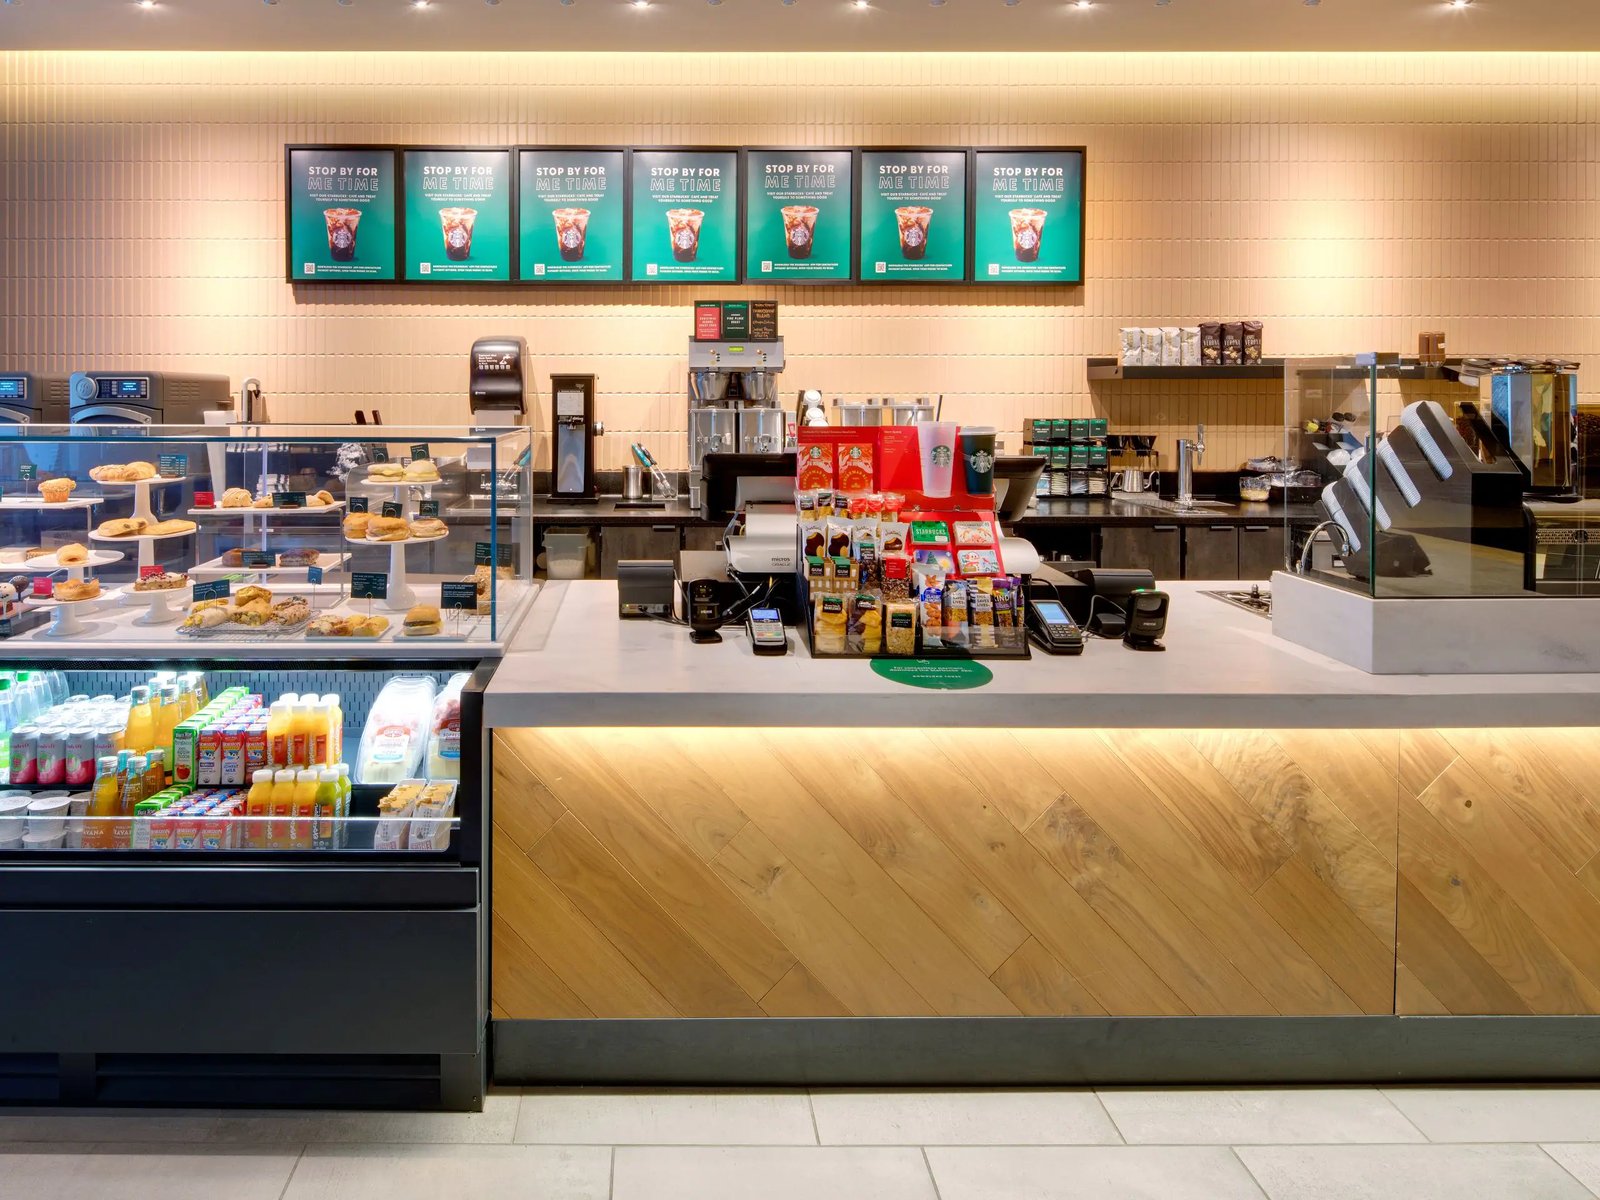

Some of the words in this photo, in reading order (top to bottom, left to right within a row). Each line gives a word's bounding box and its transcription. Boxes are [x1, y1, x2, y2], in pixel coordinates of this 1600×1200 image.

[308, 166, 336, 175] STOP
[339, 167, 353, 176] BY
[356, 167, 378, 176] FOR
[423, 166, 451, 175] STOP
[454, 166, 468, 175] BY
[471, 166, 493, 175] FOR
[536, 167, 564, 176] STOP
[567, 166, 581, 175] BY
[584, 166, 606, 175] FOR
[651, 167, 679, 176] STOP
[682, 168, 696, 177] BY
[699, 168, 721, 177] FOR
[765, 164, 793, 173] STOP
[796, 164, 810, 173] BY
[813, 164, 835, 173] FOR
[879, 165, 907, 174] STOP
[910, 165, 924, 174] BY
[927, 165, 949, 174] FOR
[993, 167, 1021, 176] STOP
[1024, 167, 1038, 176] BY
[1041, 167, 1063, 176] FOR
[307, 177, 333, 190] ME
[337, 178, 379, 191] TIME
[422, 177, 448, 190] ME
[452, 177, 494, 190] TIME
[535, 178, 561, 191] ME
[565, 177, 607, 190] TIME
[650, 178, 676, 191] ME
[680, 179, 722, 192] TIME
[764, 175, 790, 188] ME
[794, 175, 836, 188] TIME
[878, 176, 904, 189] ME
[908, 176, 950, 189] TIME
[992, 178, 1018, 191] ME
[1022, 178, 1064, 191] TIME
